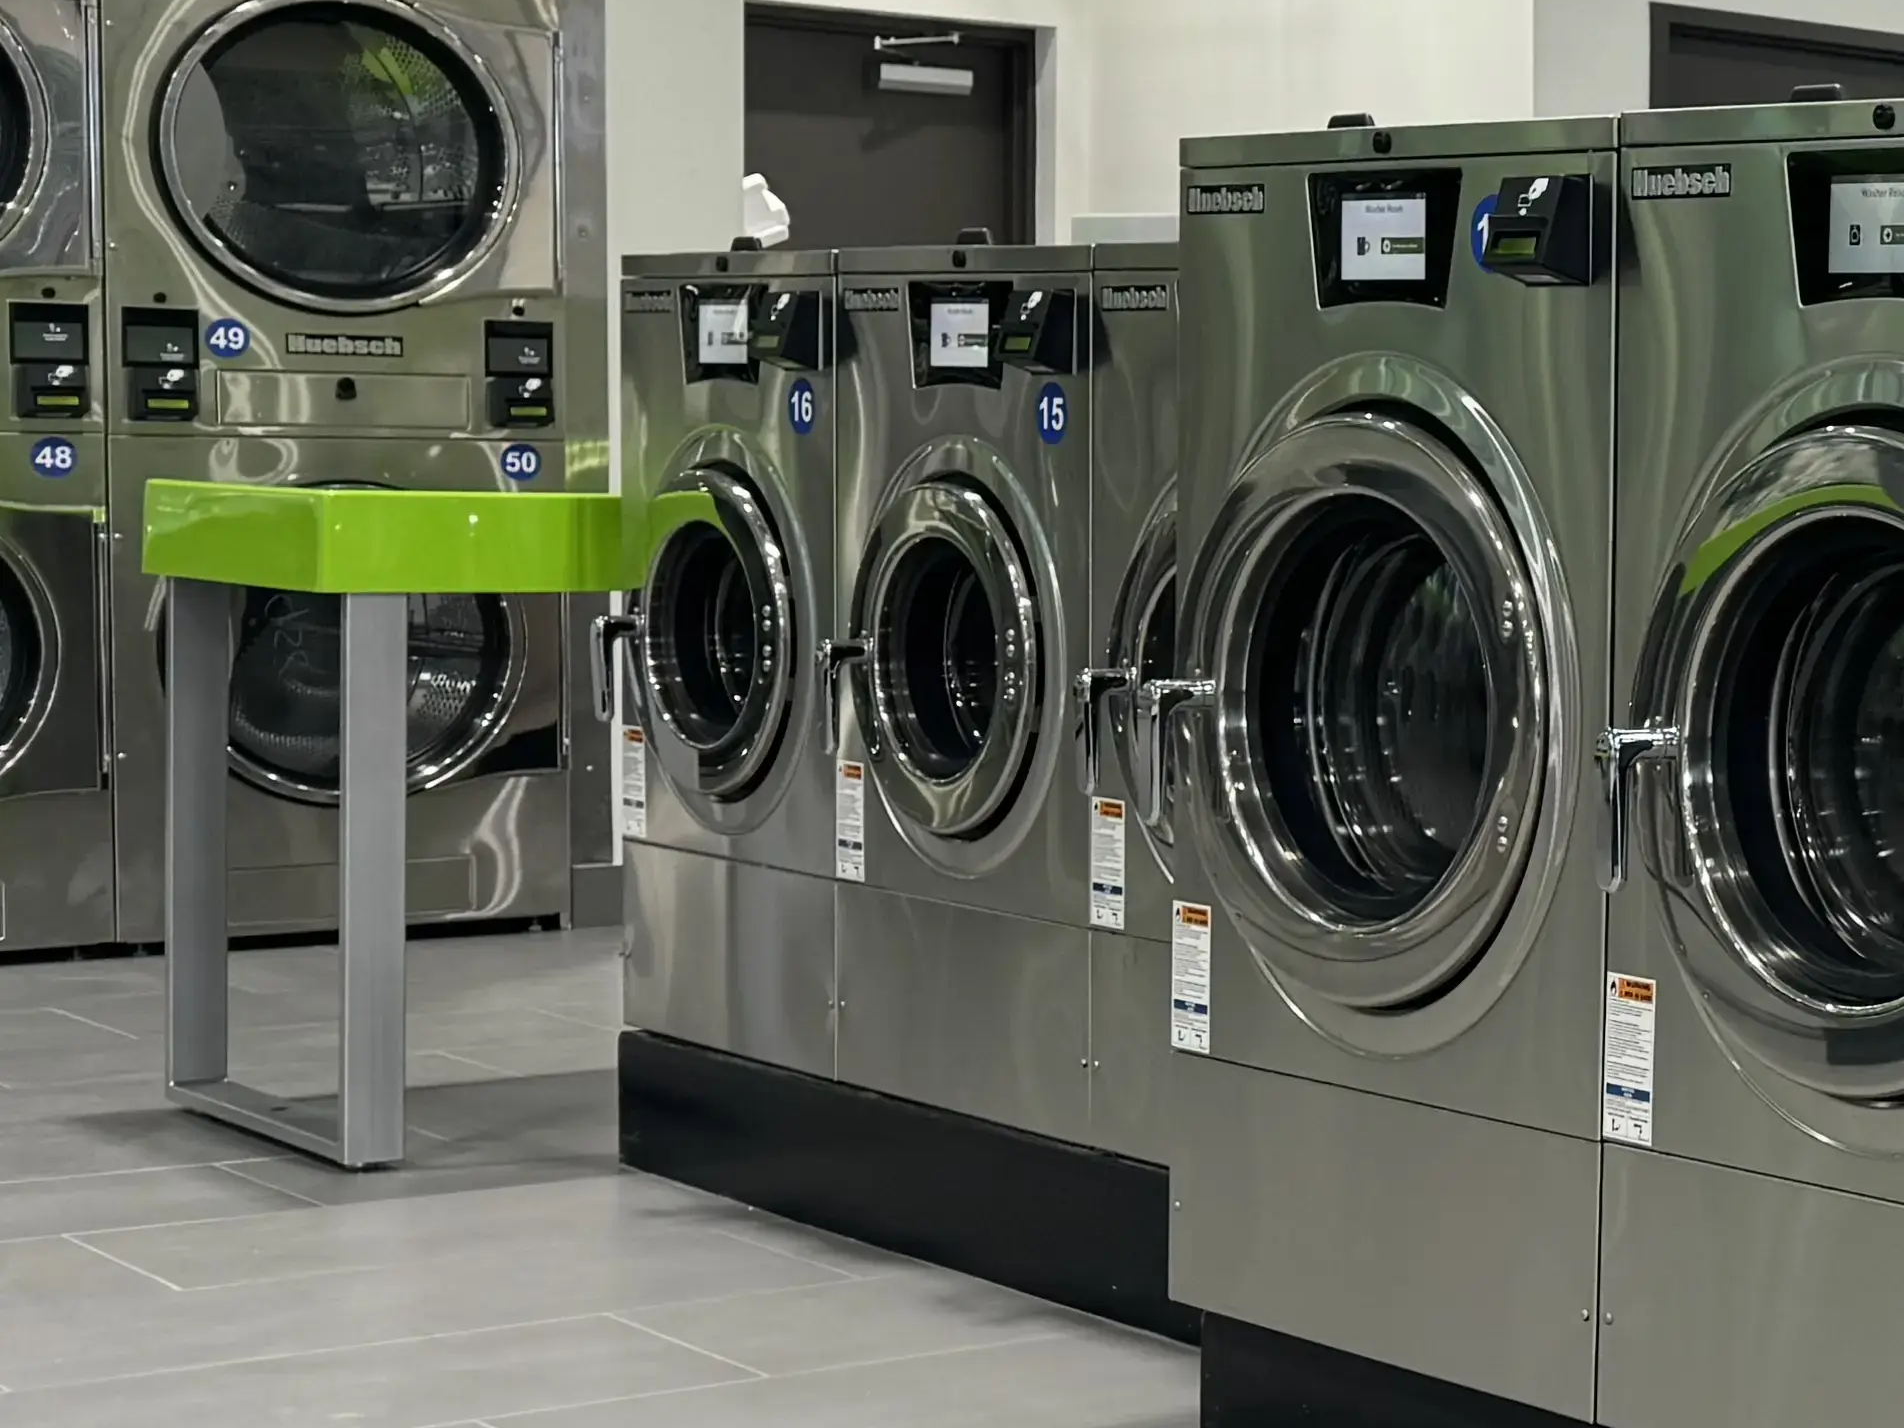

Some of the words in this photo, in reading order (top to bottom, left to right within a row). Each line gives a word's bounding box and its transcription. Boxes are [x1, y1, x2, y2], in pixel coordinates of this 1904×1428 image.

[1633, 166, 1730, 196] Huebsch
[209, 327, 245, 350] 49
[287, 334, 401, 355] Huebsch
[790, 390, 813, 423] 16
[1039, 396, 1064, 431] 15
[34, 446, 73, 469] 48
[505, 451, 537, 473] 50
